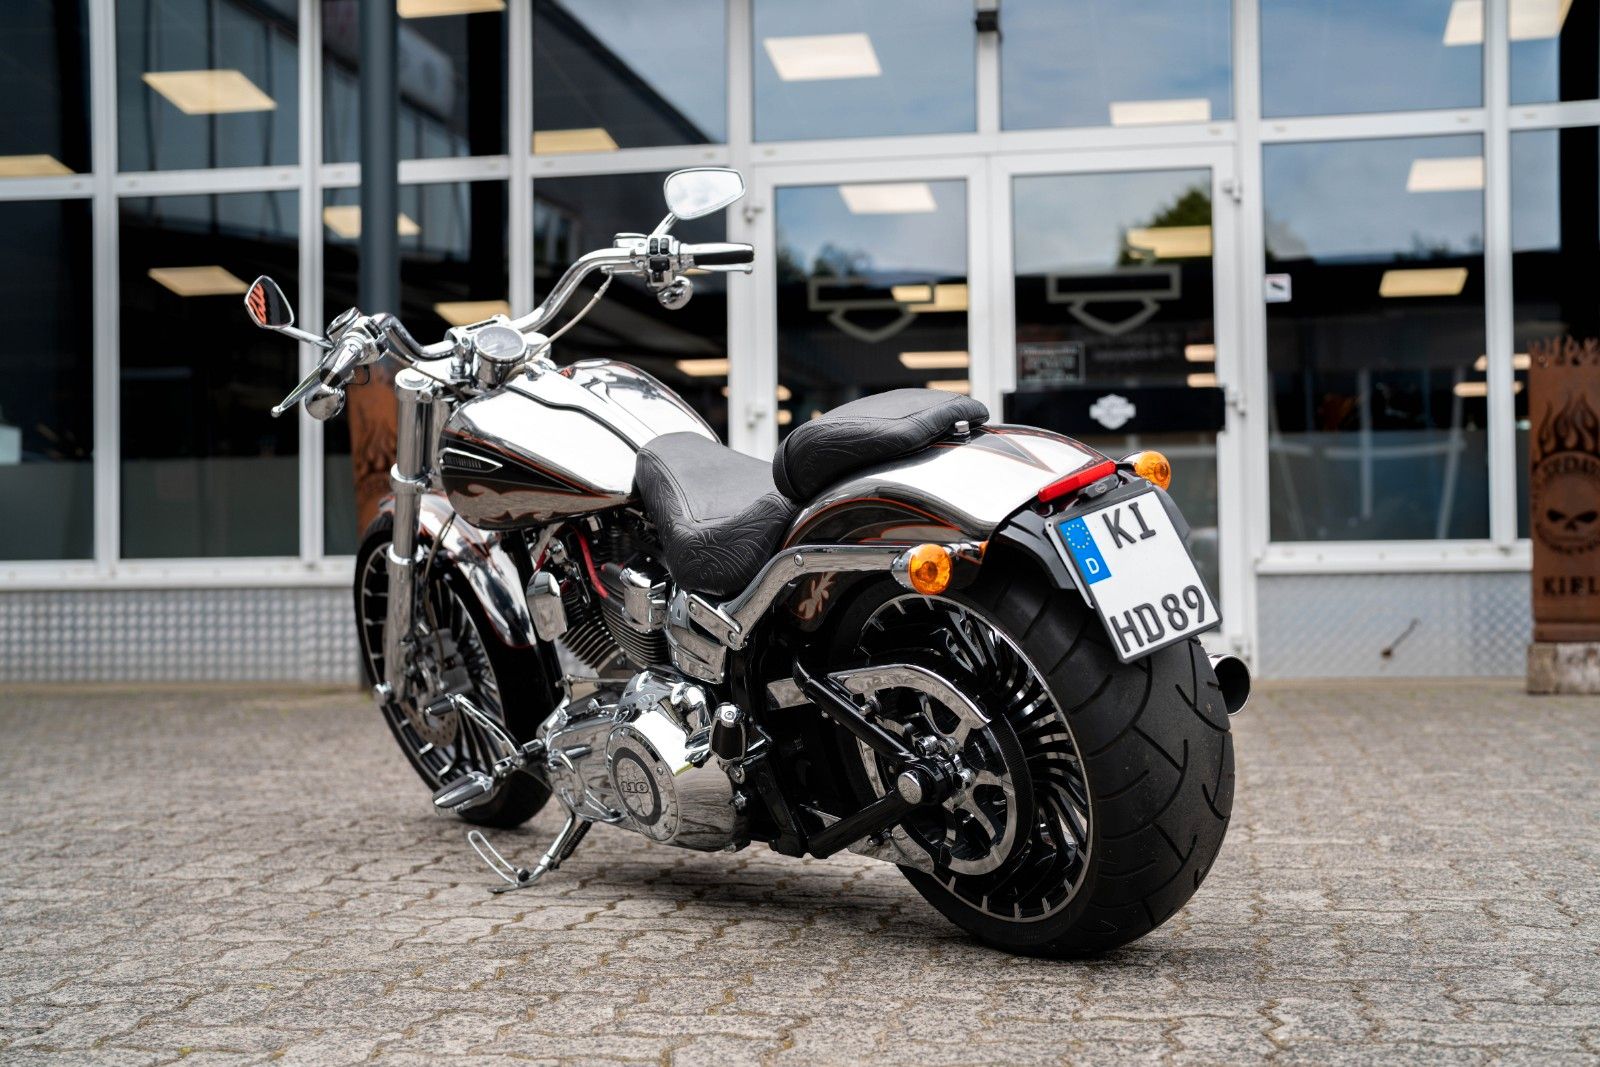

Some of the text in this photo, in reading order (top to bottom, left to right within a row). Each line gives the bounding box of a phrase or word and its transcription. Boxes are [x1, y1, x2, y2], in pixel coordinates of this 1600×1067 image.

[1102, 502, 1157, 549] KI
[1085, 557, 1100, 575] D
[621, 781, 650, 794] 110
